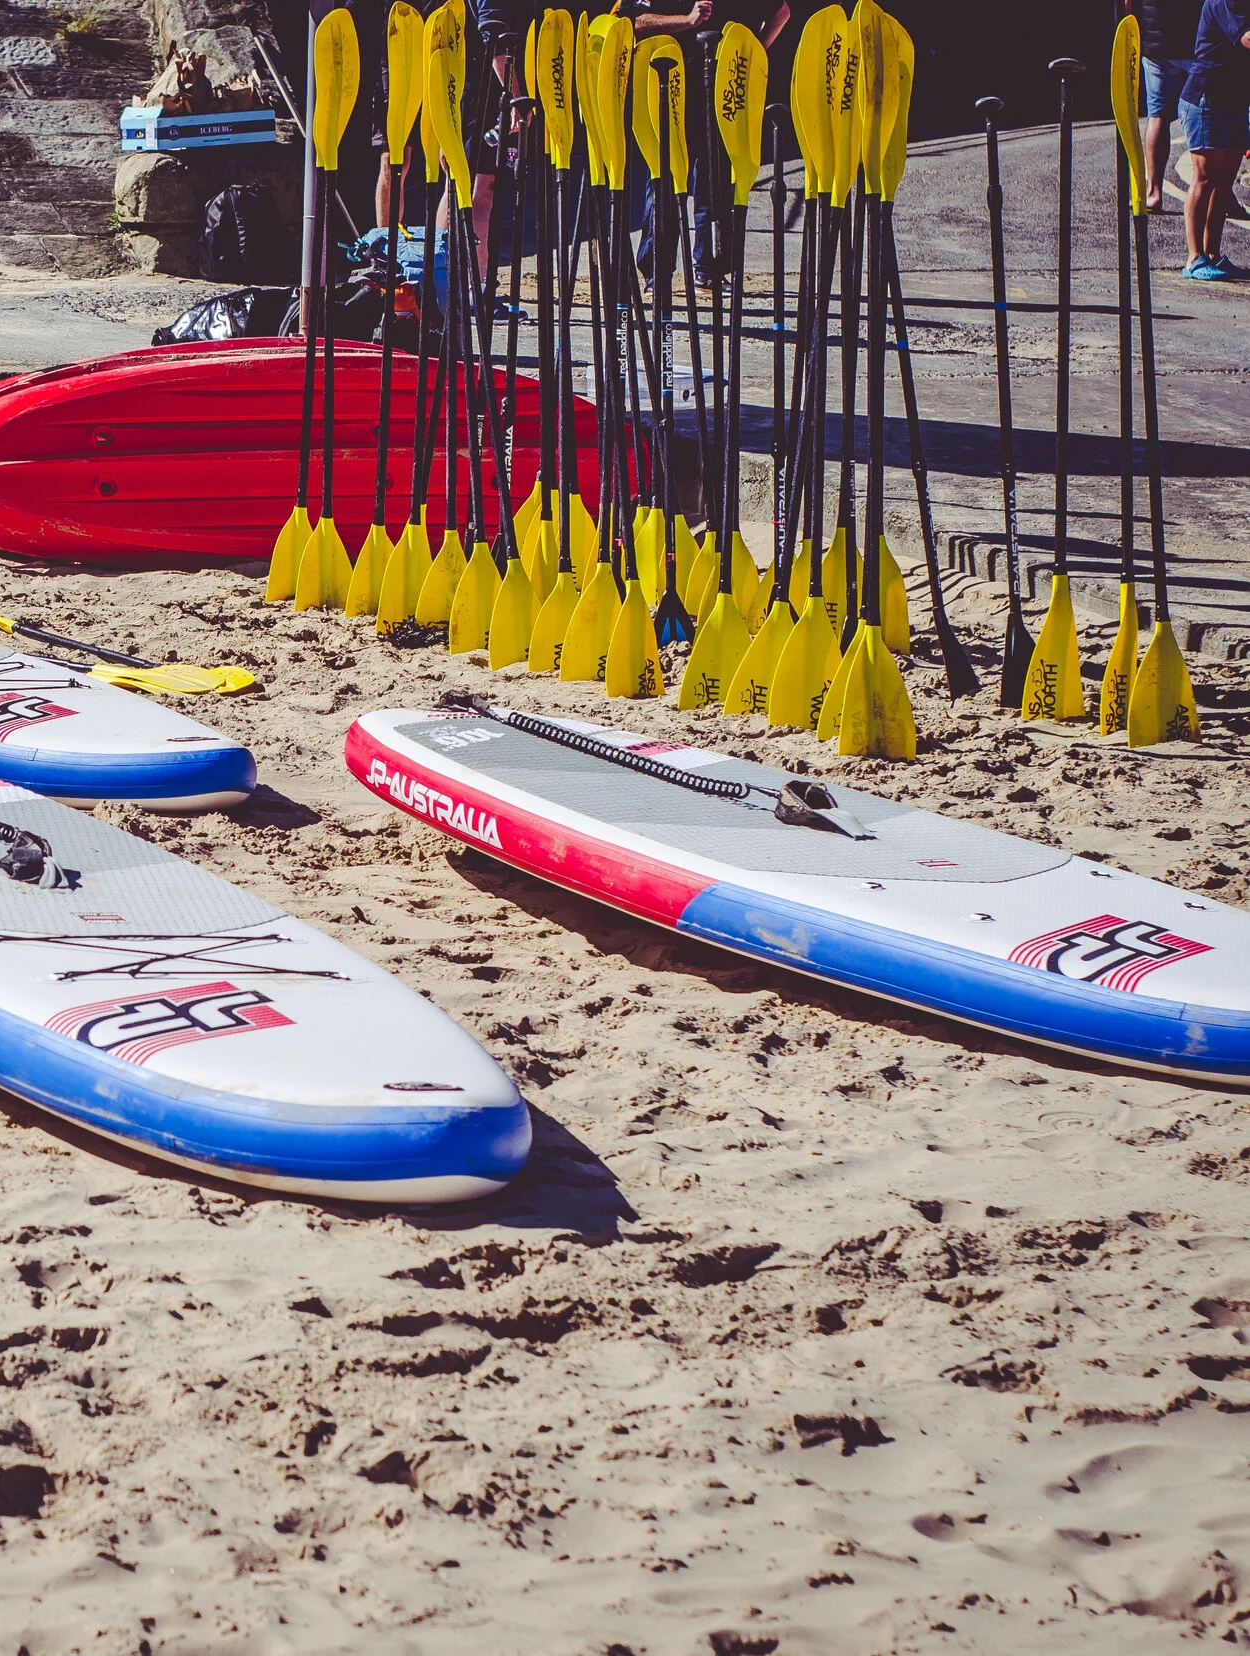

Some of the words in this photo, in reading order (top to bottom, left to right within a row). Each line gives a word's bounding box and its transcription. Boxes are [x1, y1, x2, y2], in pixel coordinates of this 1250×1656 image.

[735, 55, 748, 111] WORTH
[200, 125, 233, 134] ICEBERG
[661, 371, 672, 387] red
[1043, 664, 1058, 720] WORTH
[366, 758, 504, 850] JP-AUSTRALIA
